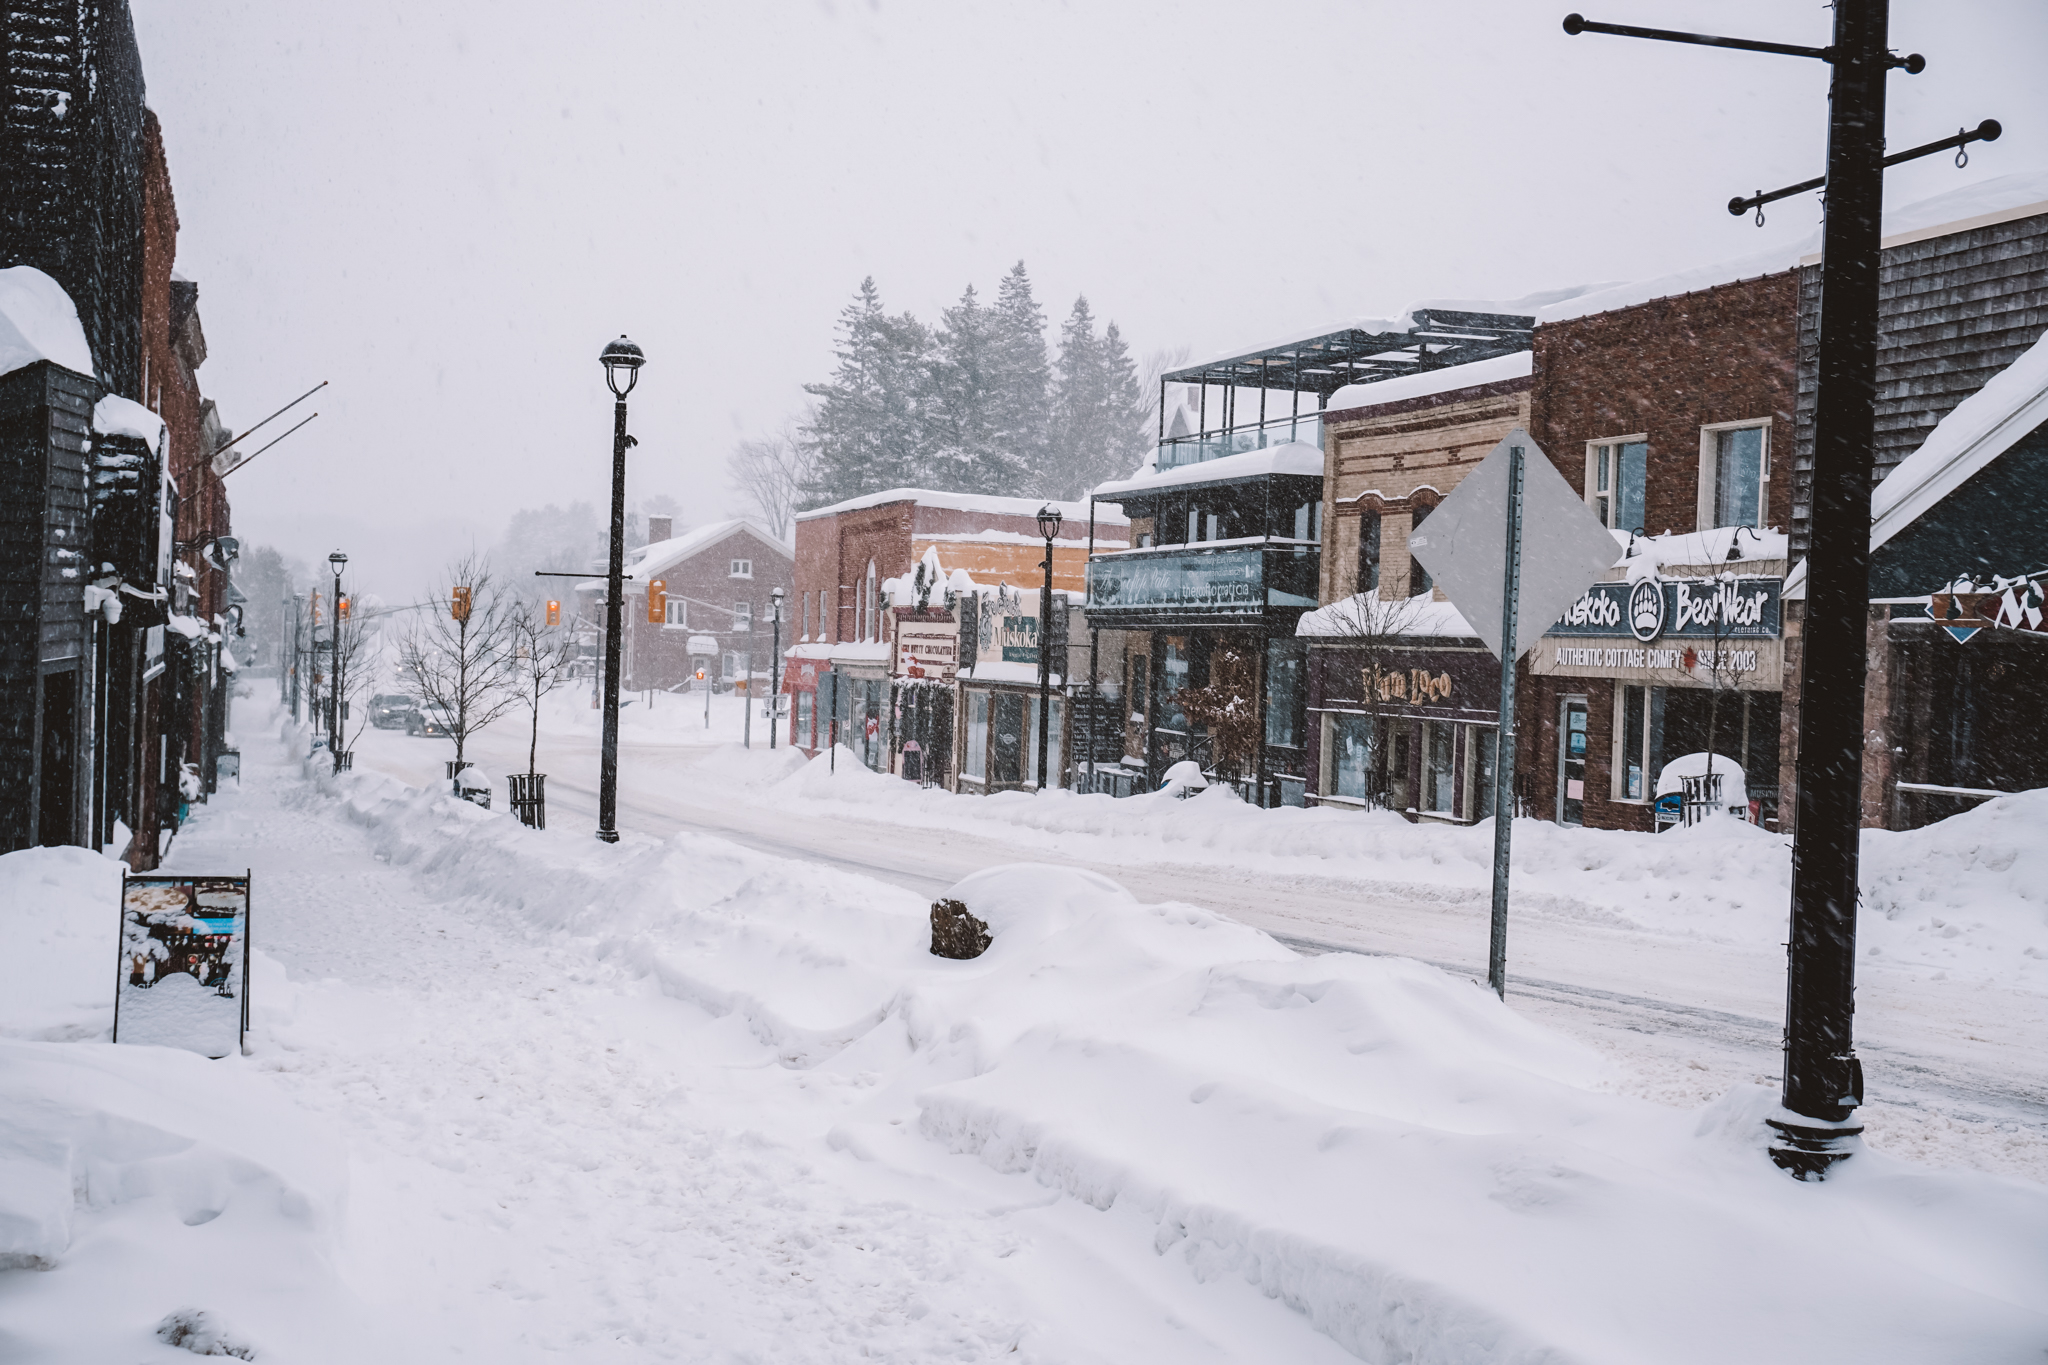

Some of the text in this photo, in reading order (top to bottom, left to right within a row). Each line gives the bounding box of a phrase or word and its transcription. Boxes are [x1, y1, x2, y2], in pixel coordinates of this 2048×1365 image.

[1557, 589, 1620, 627] uskoka
[993, 624, 1038, 648] Muskoka
[1556, 647, 1603, 667] AUTHENTIC
[1605, 648, 1645, 668] COTTAGE
[1647, 648, 1681, 669] COMFY
[1730, 650, 1757, 671] 2003
